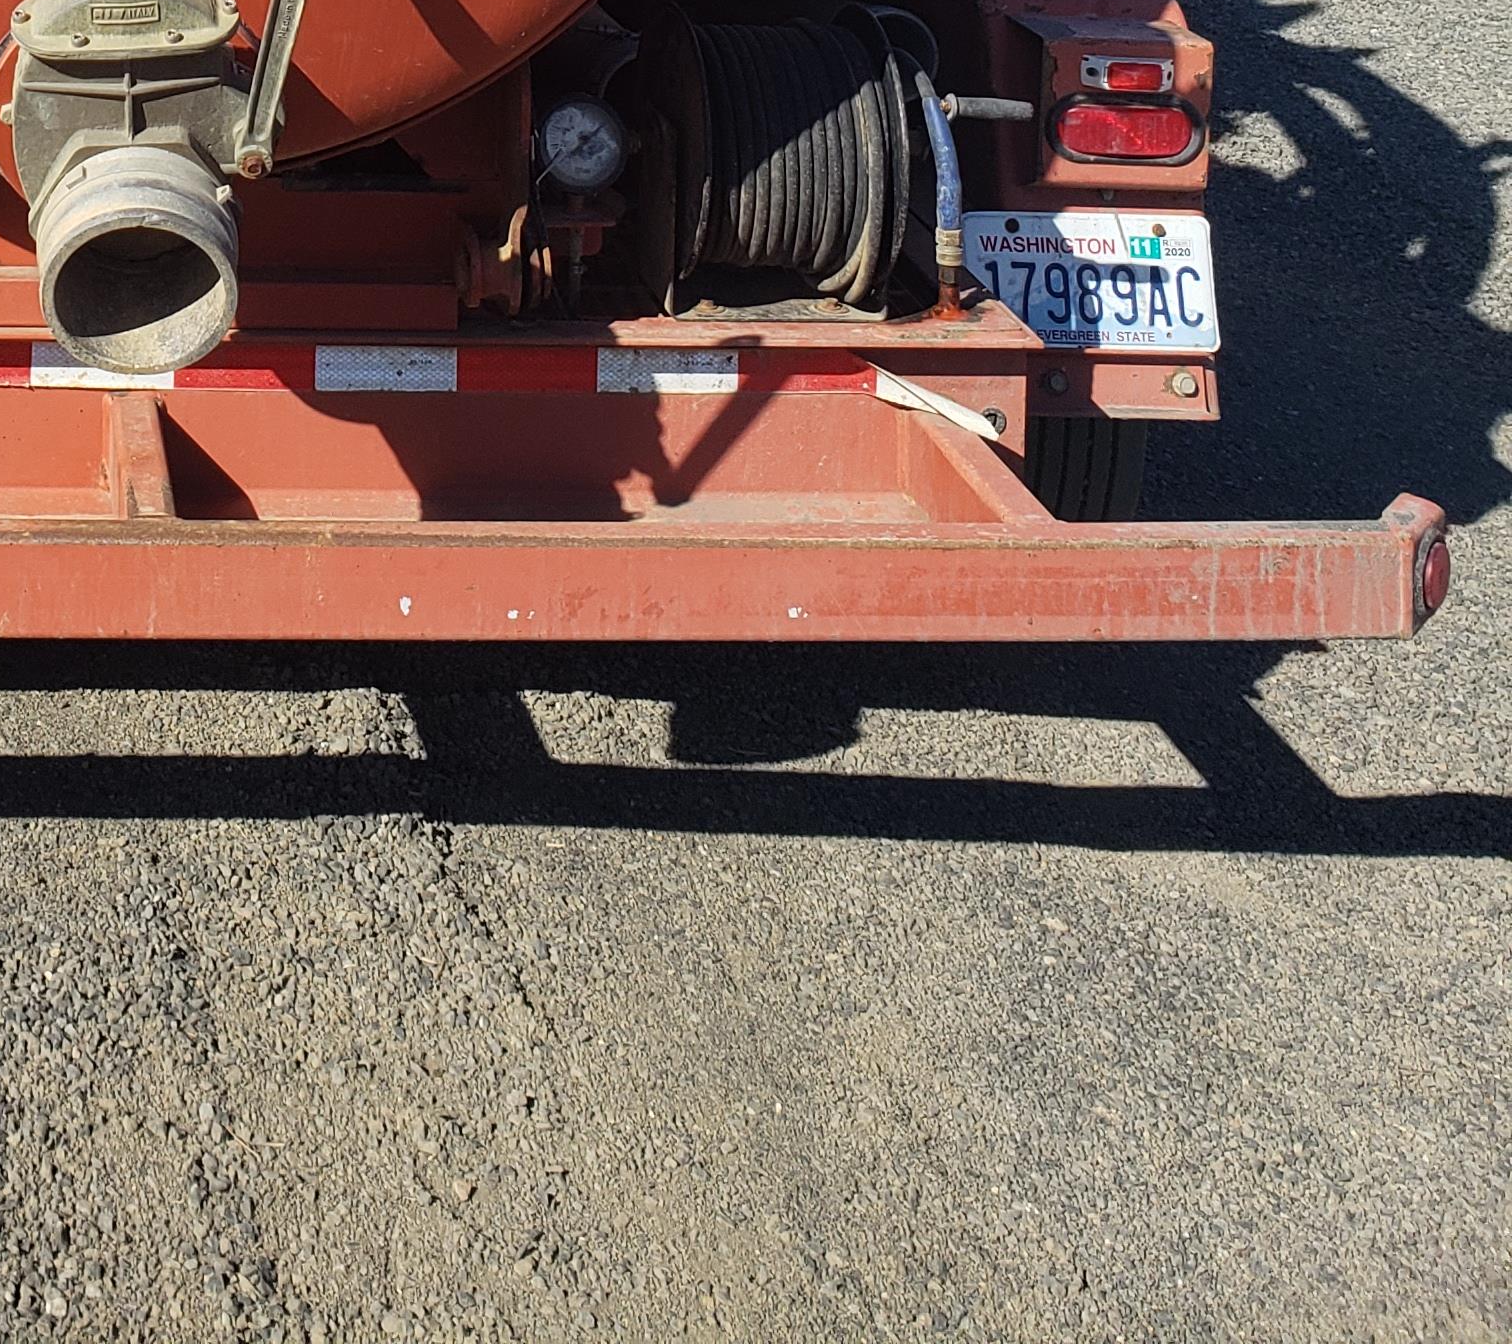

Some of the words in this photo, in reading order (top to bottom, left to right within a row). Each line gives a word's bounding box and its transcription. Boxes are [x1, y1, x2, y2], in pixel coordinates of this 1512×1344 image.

[979, 234, 1116, 255] WASHINGTON
[1130, 237, 1152, 256] 11
[1164, 247, 1191, 257] 2020
[984, 260, 1204, 328] 17989AC
[1038, 329, 1110, 342] EVERGREEN
[1116, 330, 1156, 343] STATE
